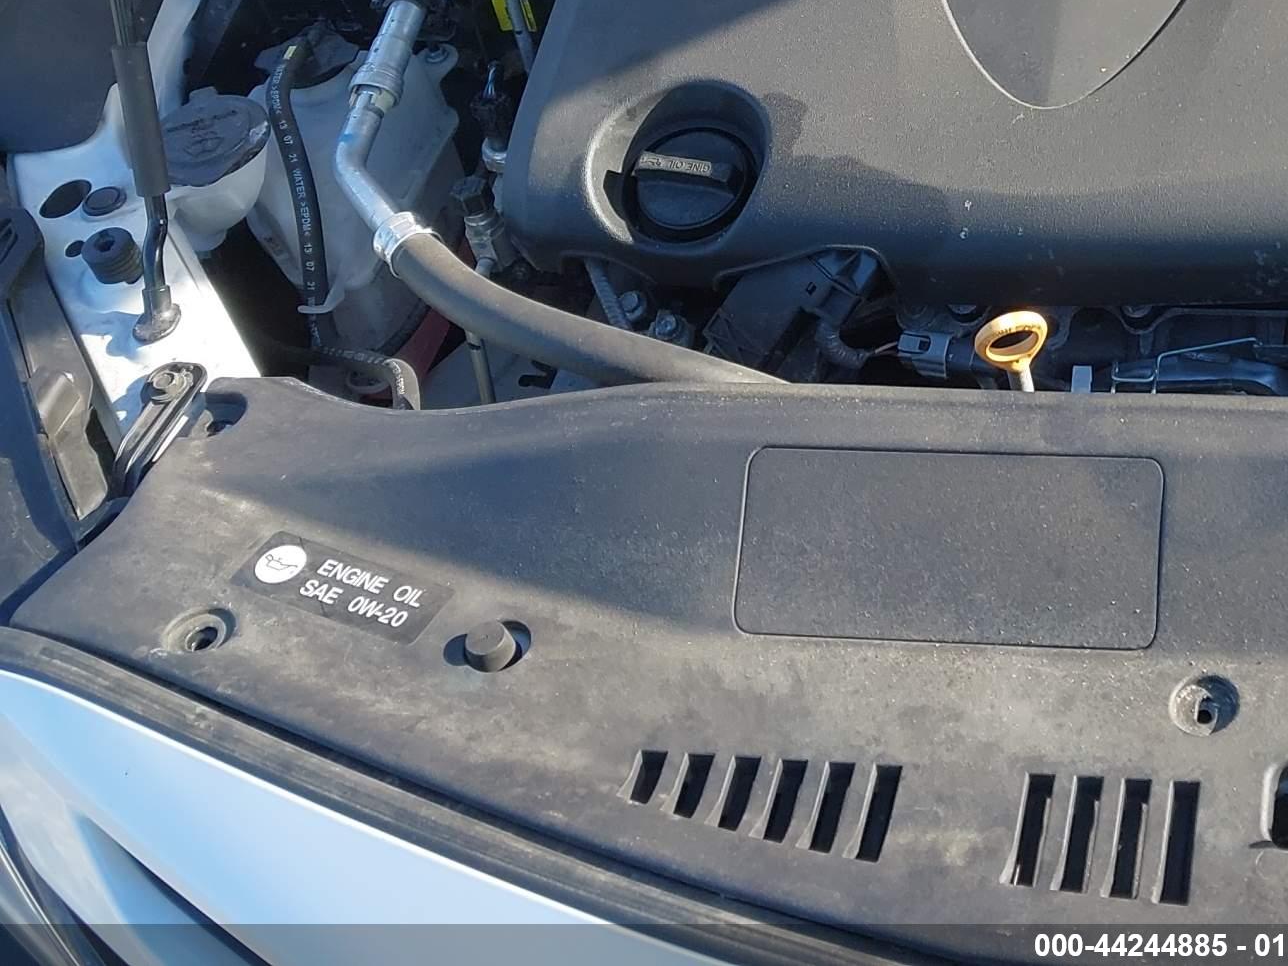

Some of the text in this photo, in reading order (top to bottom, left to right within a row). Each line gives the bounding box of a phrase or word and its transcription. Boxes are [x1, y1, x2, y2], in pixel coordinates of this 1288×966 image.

[669, 159, 684, 169] OIL
[283, 135, 293, 145] 07
[292, 168, 306, 199] WATER
[306, 261, 315, 271] 07
[300, 579, 409, 628] SAE 0W-20
[317, 559, 426, 608] ENGINE OIL
